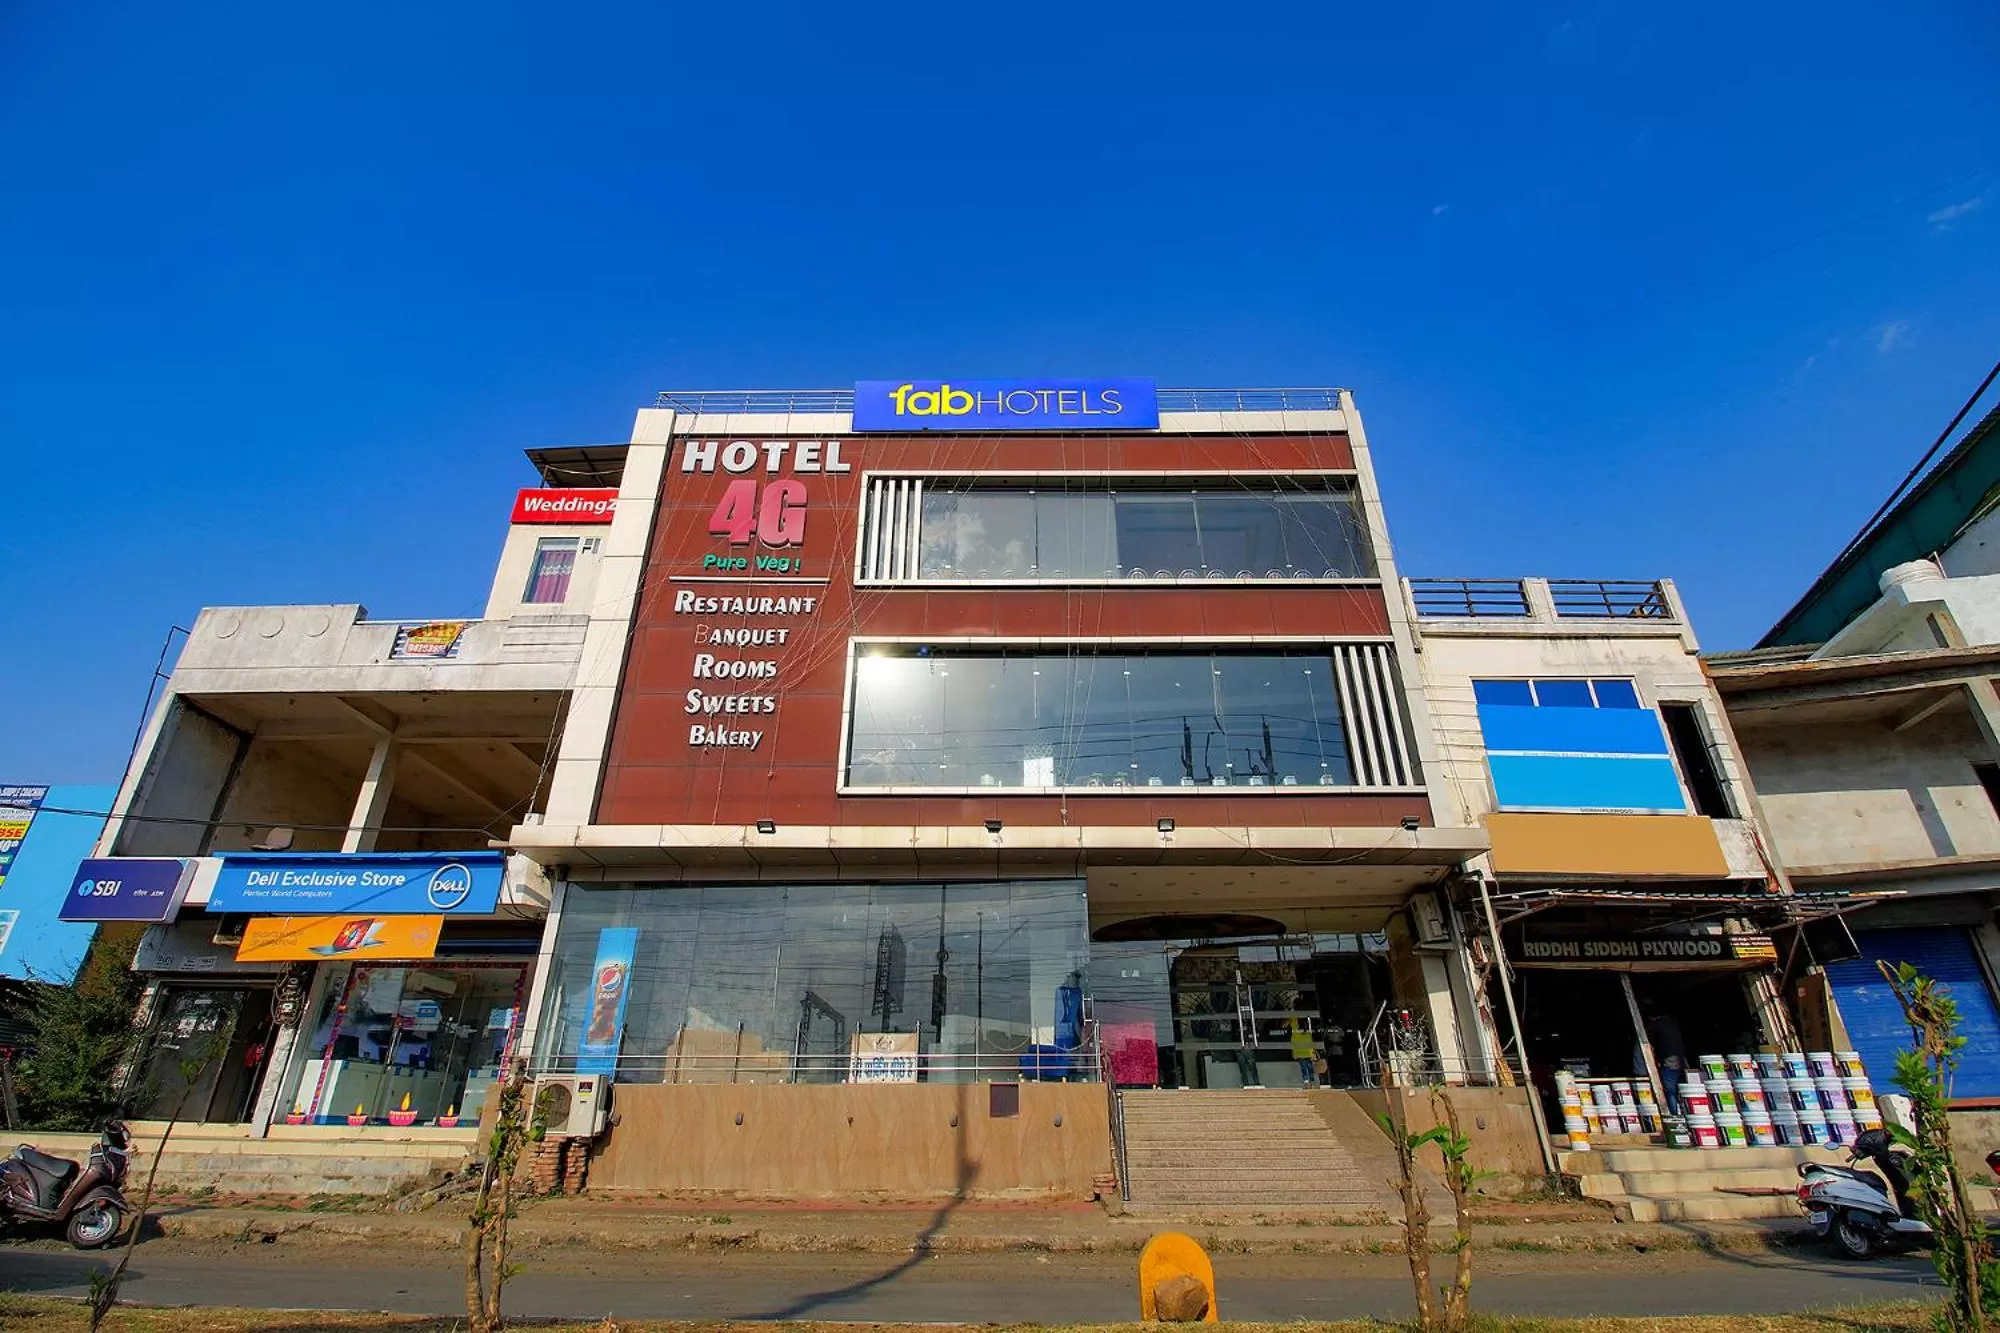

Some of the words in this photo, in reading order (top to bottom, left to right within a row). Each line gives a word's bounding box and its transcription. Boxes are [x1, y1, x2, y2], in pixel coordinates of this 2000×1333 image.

[889, 384, 1122, 416] fabHOTELS
[682, 441, 851, 473] HOTEL
[708, 479, 808, 549] 4G
[703, 554, 748, 570] Pure
[674, 590, 816, 614] RESTAURANT
[694, 624, 789, 647] BANQUET
[692, 653, 777, 678] ROOMS
[684, 688, 776, 714] SWEETS
[92, 880, 121, 897] SBI
[246, 871, 279, 886] Dell
[281, 871, 357, 886] Exclusive
[360, 871, 406, 886] Store
[432, 880, 465, 892] DELL
[1523, 941, 1579, 957] RIDDHI
[1583, 941, 1638, 957] SIDDHI
[1642, 940, 1722, 956] PLYWOOD
